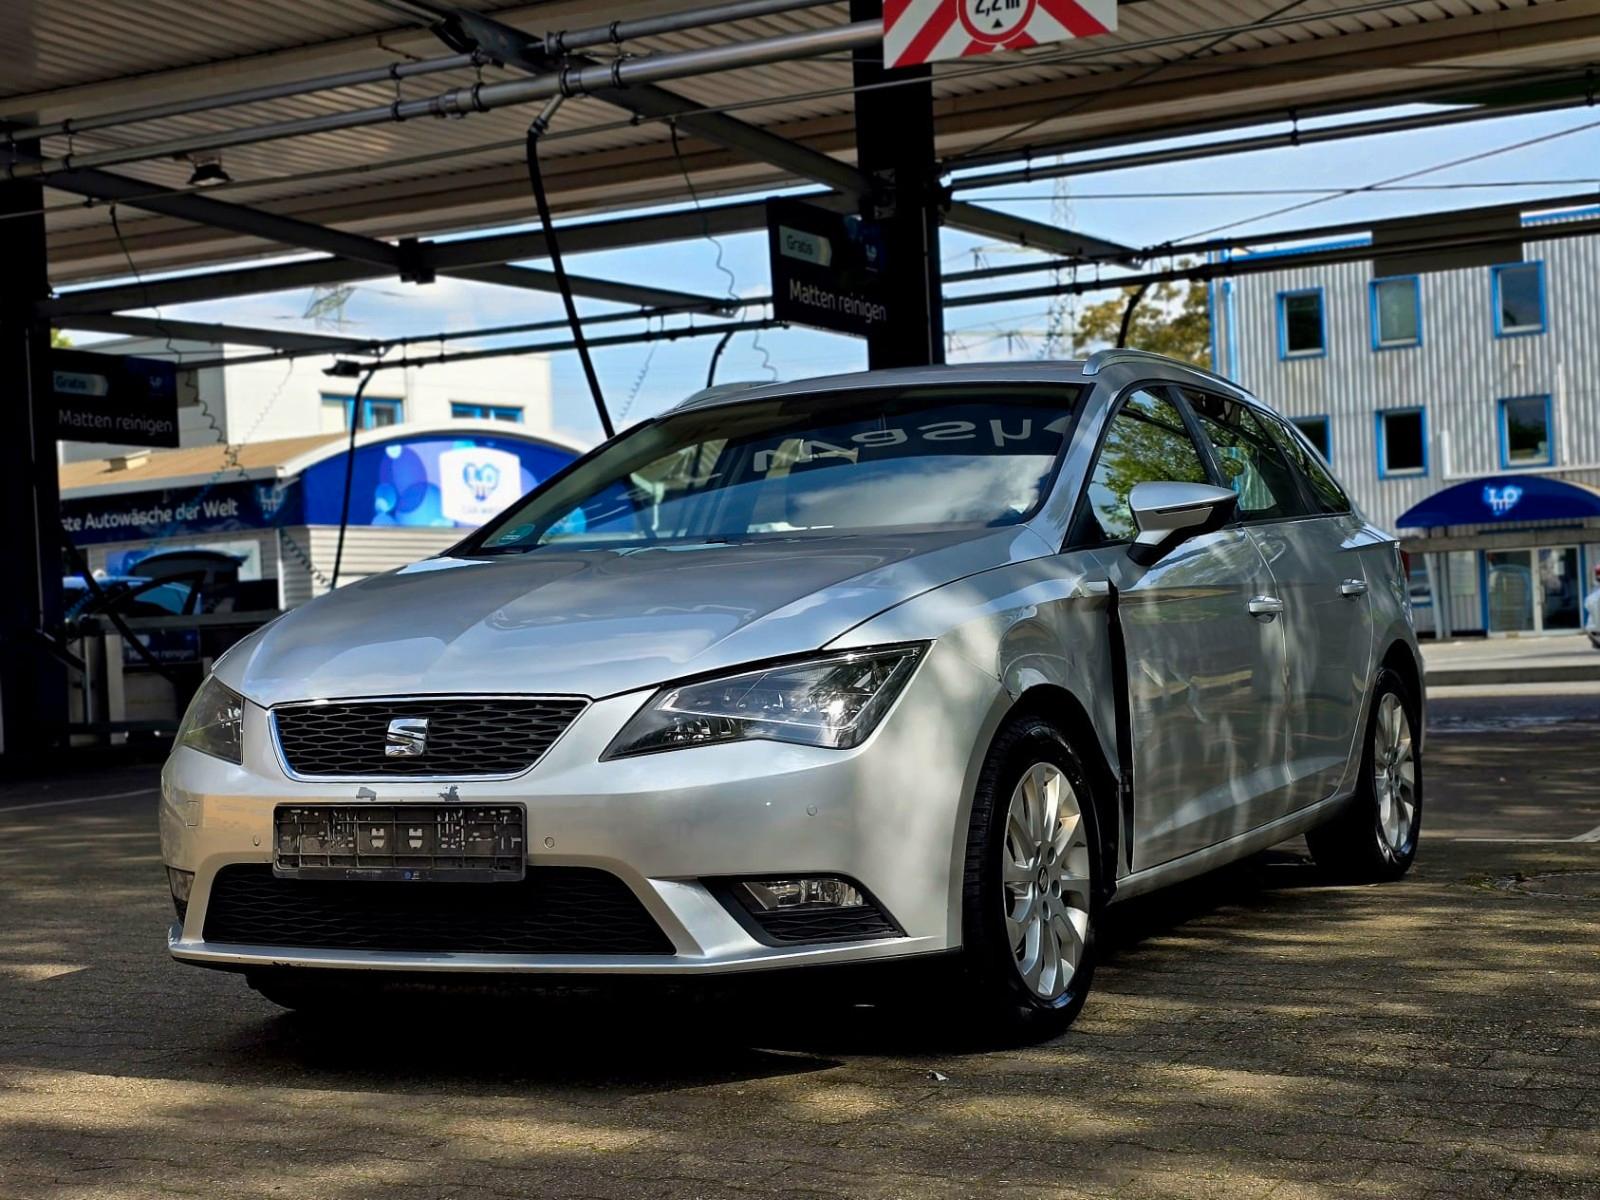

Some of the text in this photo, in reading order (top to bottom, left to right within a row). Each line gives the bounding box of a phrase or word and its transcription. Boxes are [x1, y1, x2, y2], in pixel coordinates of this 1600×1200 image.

[789, 278, 887, 324] Matten reinigen
[58, 408, 173, 436] Matten reinigen
[84, 505, 173, 531] Autowäsche
[175, 502, 201, 521] der
[202, 497, 239, 519] Welt
